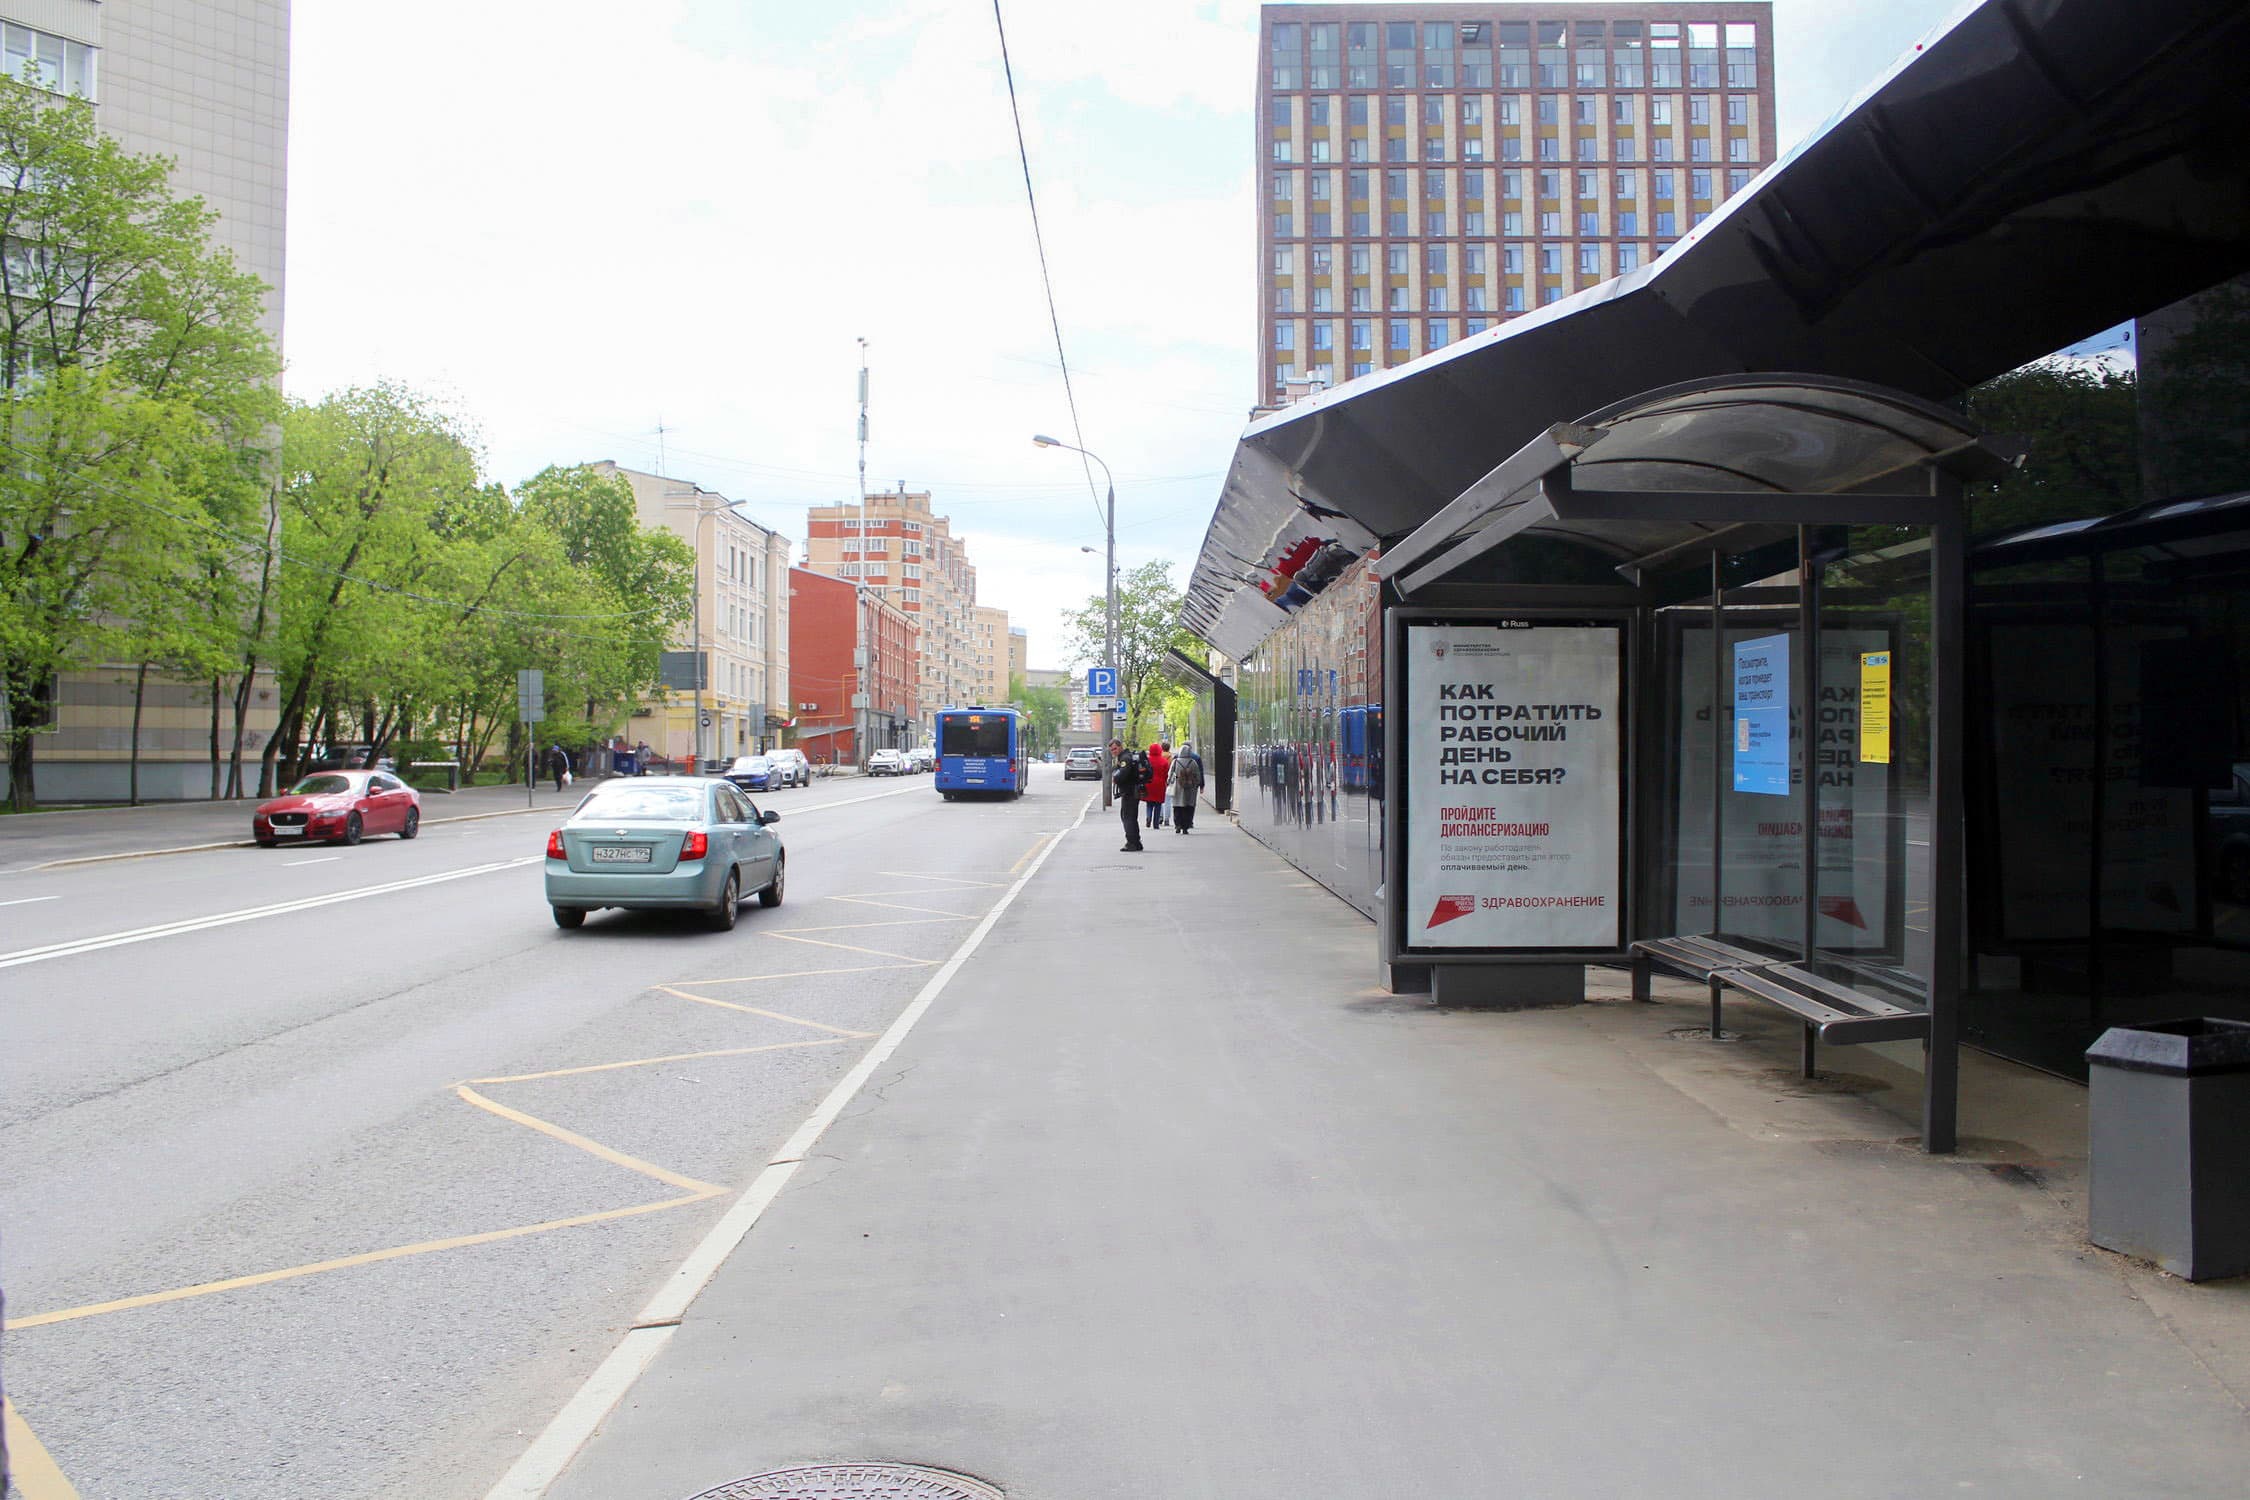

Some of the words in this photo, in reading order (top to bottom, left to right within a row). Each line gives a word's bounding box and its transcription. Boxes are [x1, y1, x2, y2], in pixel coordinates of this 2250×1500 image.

[1095, 671, 1111, 693] P
[1440, 684, 1494, 699] КАК
[1440, 705, 1602, 720] ПОТРАТИТЬ
[1441, 722, 1566, 741] РАБОЧИЙ
[1440, 747, 1512, 766] ДЕНЬ
[1441, 769, 1477, 784] НА
[1482, 767, 1566, 784] СЕБЯ?
[1441, 804, 1496, 821] ПРОЙДИТЕ
[1441, 823, 1550, 838] ДИСПАНСЕРИЗАЦИЮ
[1441, 863, 1505, 872] оплачиваемый
[1481, 896, 1605, 910] ЗДРАВООХРАНЕНИЕ
